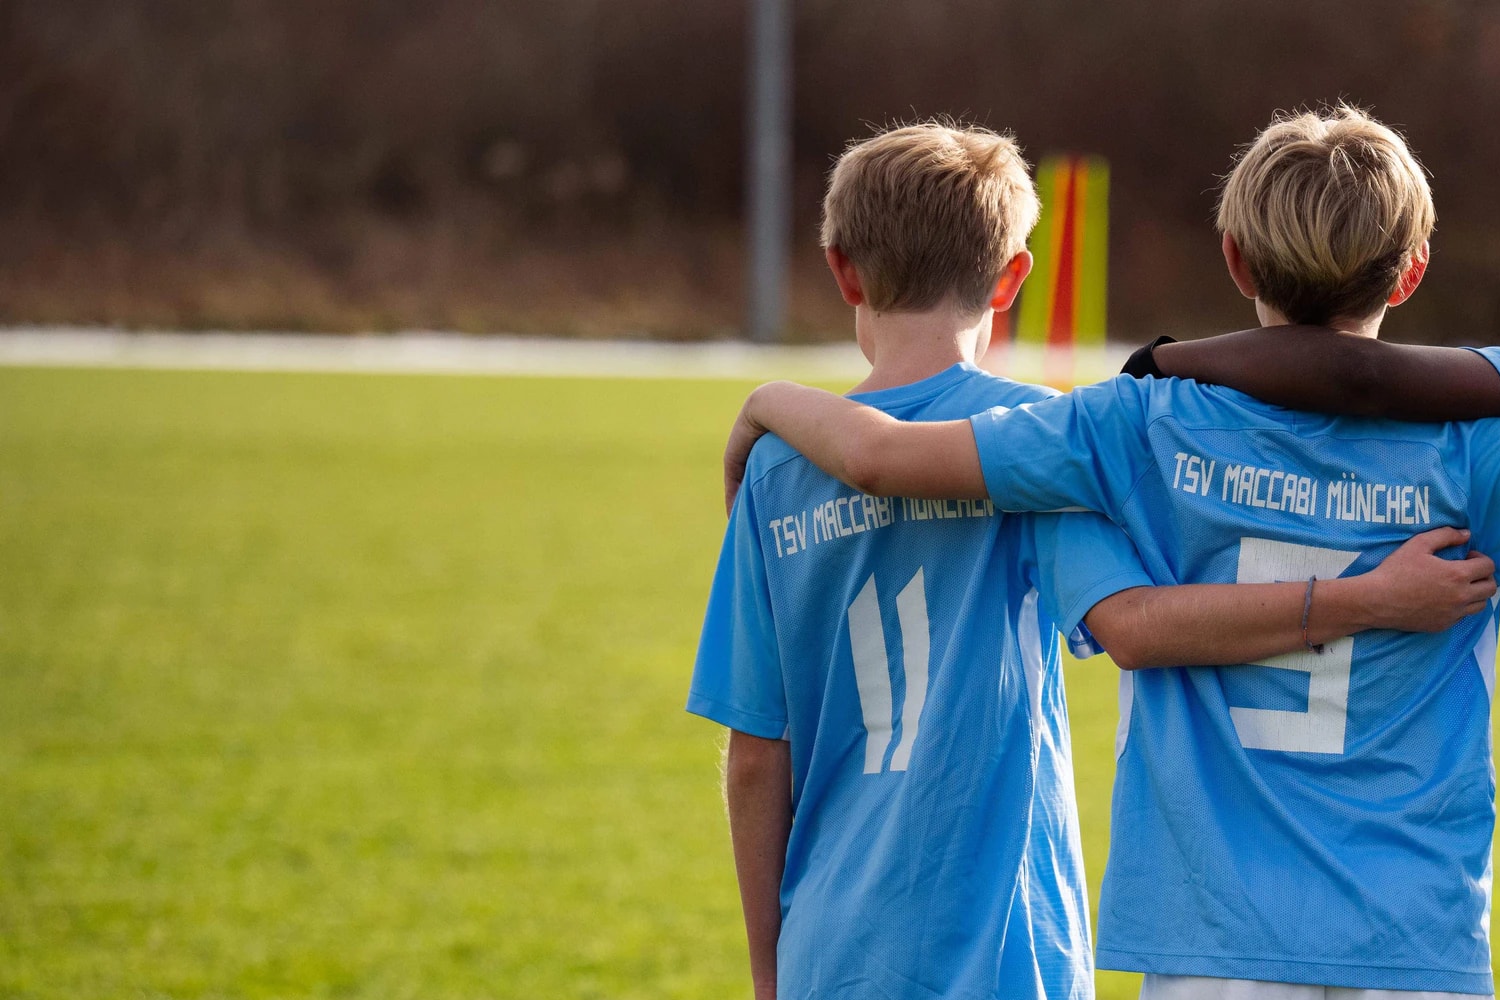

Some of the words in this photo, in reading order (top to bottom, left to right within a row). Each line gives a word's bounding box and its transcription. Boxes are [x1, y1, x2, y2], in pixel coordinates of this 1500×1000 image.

[1173, 452, 1216, 497] TSV
[1222, 463, 1318, 516] MACCABI
[1325, 472, 1430, 525] MÜNCHEN
[769, 511, 806, 558] TSV
[813, 493, 896, 544] MACCABI
[847, 565, 930, 775] 11
